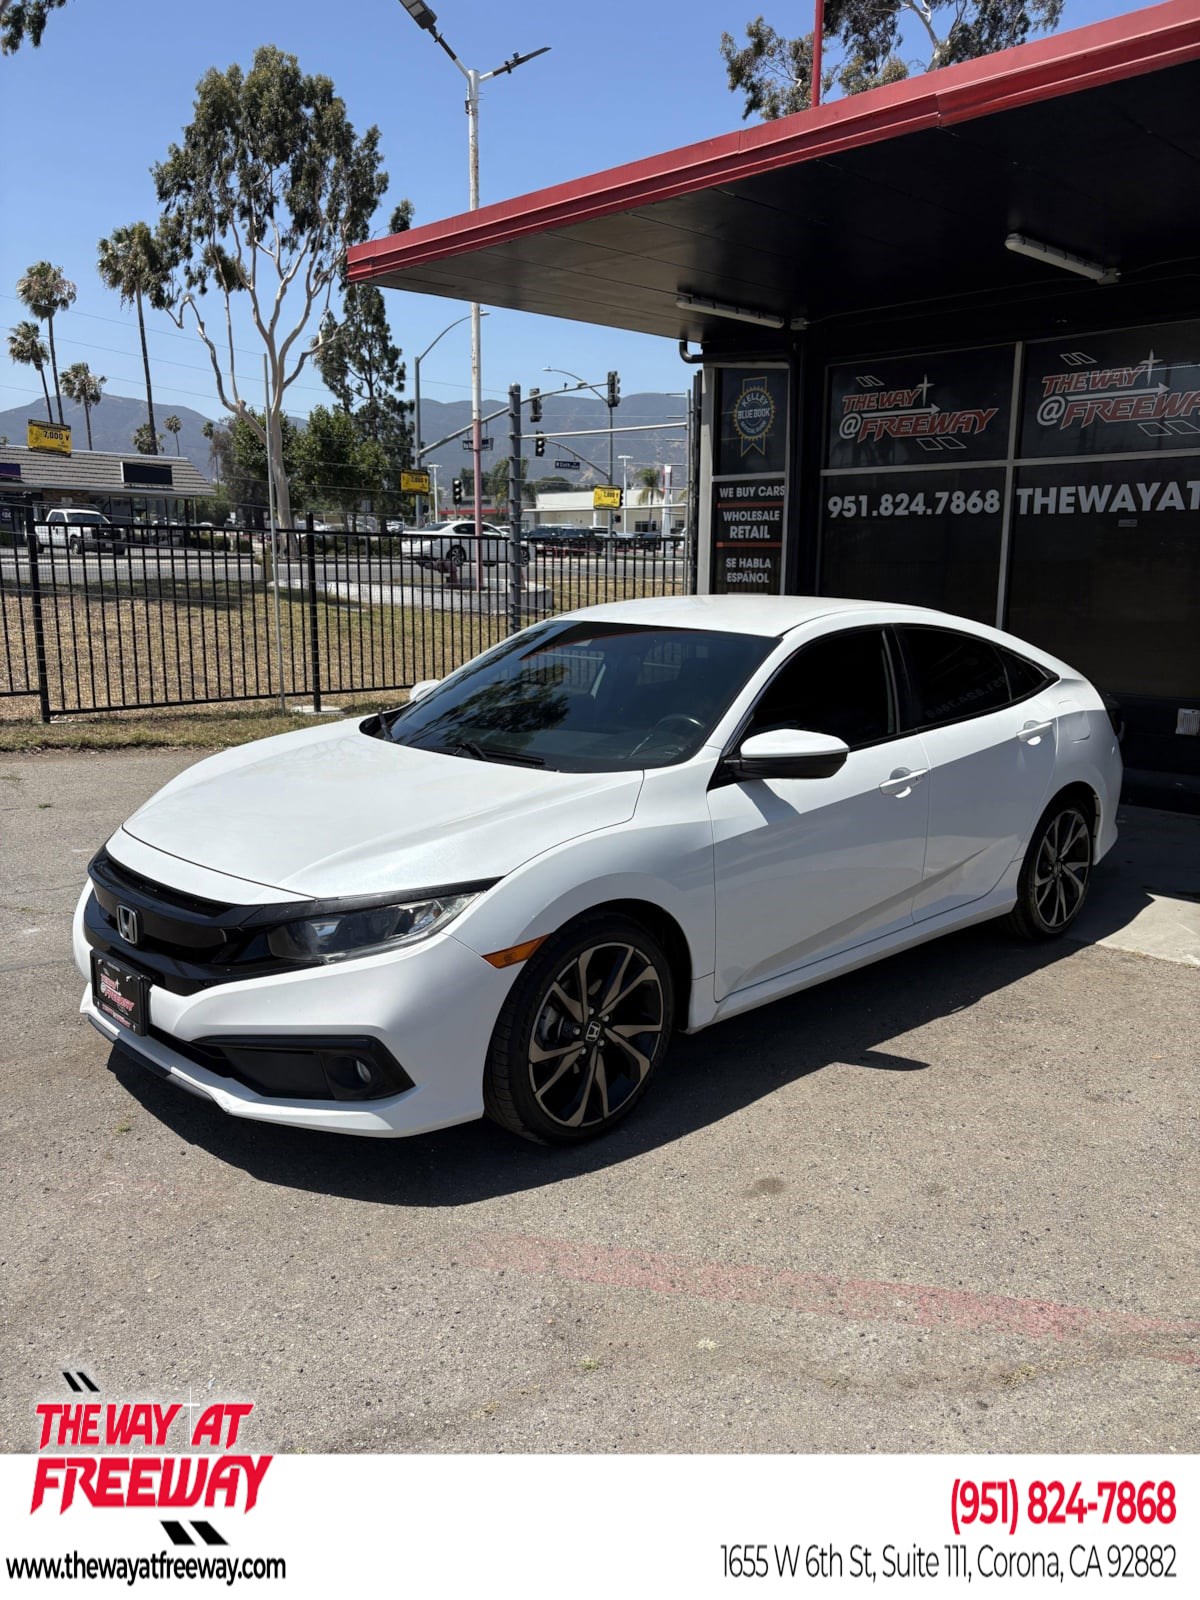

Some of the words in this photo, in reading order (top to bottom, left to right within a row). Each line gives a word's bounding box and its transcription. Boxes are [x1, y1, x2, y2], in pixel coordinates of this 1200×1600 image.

[741, 391, 769, 408] KELLEY
[842, 392, 879, 414] THE
[878, 388, 922, 409] WAY
[737, 409, 753, 420] BLUE
[753, 407, 771, 418] BOOK
[719, 487, 734, 498] WE
[736, 486, 756, 498] BUY
[758, 485, 786, 497] CARS
[1016, 480, 1200, 515] THEWAYAT
[827, 489, 1001, 518] 951.824.7868
[723, 510, 780, 522] WHOLESALE
[729, 525, 771, 539] RETAIL
[726, 557, 737, 568] SE
[738, 557, 772, 569] HABLA
